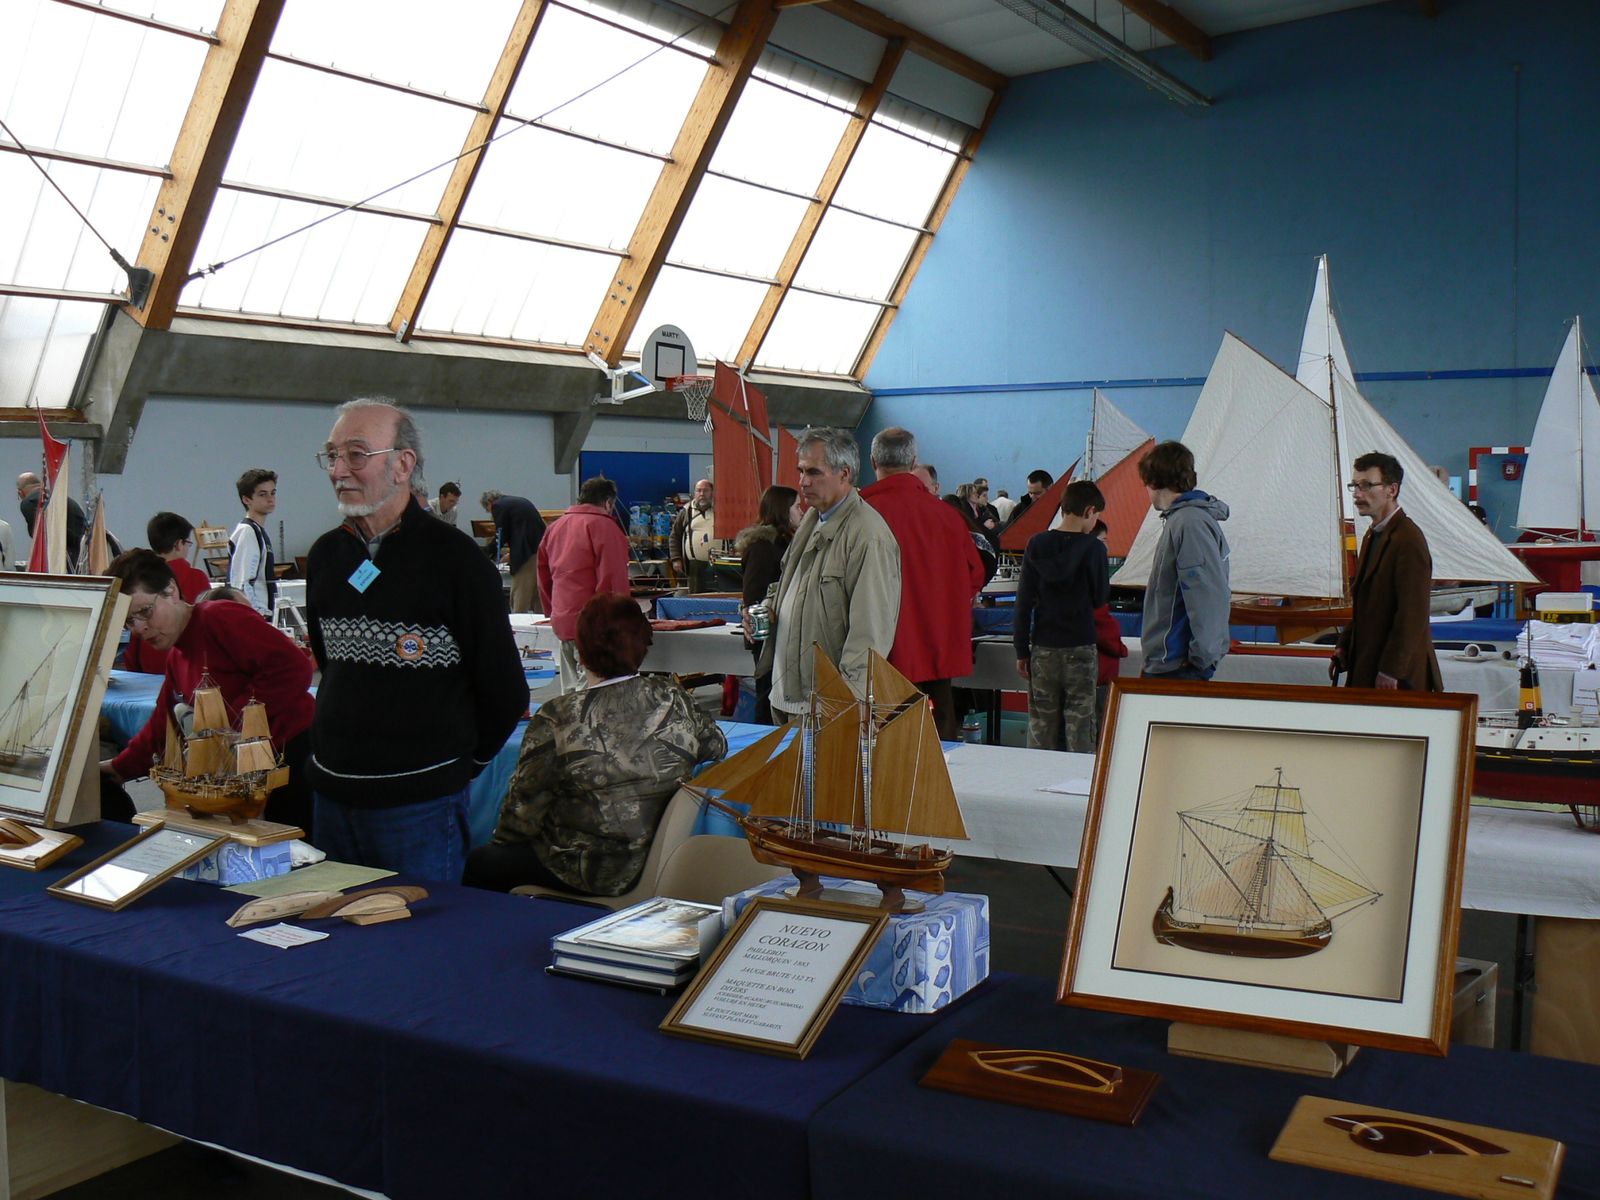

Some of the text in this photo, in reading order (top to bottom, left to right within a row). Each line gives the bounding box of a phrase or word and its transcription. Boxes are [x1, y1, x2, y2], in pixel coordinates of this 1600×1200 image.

[662, 330, 679, 338] MARTY
[779, 925, 831, 938] NUEVO
[759, 935, 830, 952] CORAZON
[766, 970, 791, 978] BRUTE
[726, 978, 766, 988] MAQUETTE
[720, 985, 748, 994] DIVERS
